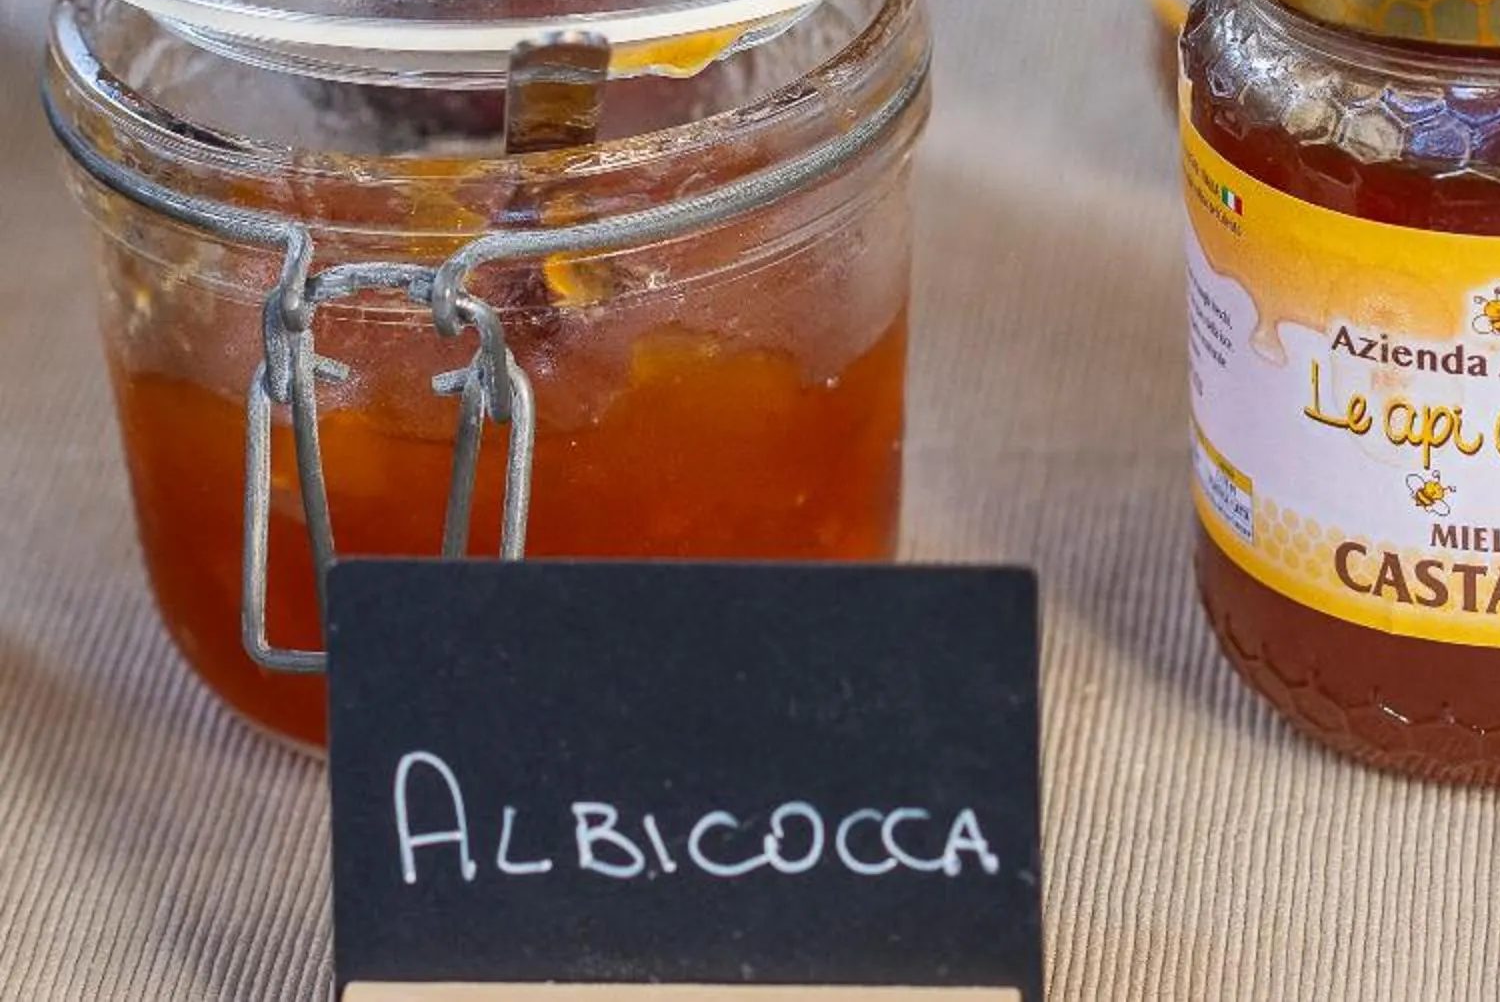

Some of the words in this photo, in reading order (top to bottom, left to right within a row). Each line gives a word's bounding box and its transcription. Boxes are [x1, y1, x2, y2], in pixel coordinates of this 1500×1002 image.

[1331, 325, 1488, 378] Azienda
[1303, 358, 1374, 435] Le
[1383, 398, 1484, 470] api
[394, 751, 1000, 885] ALBICOCCA
